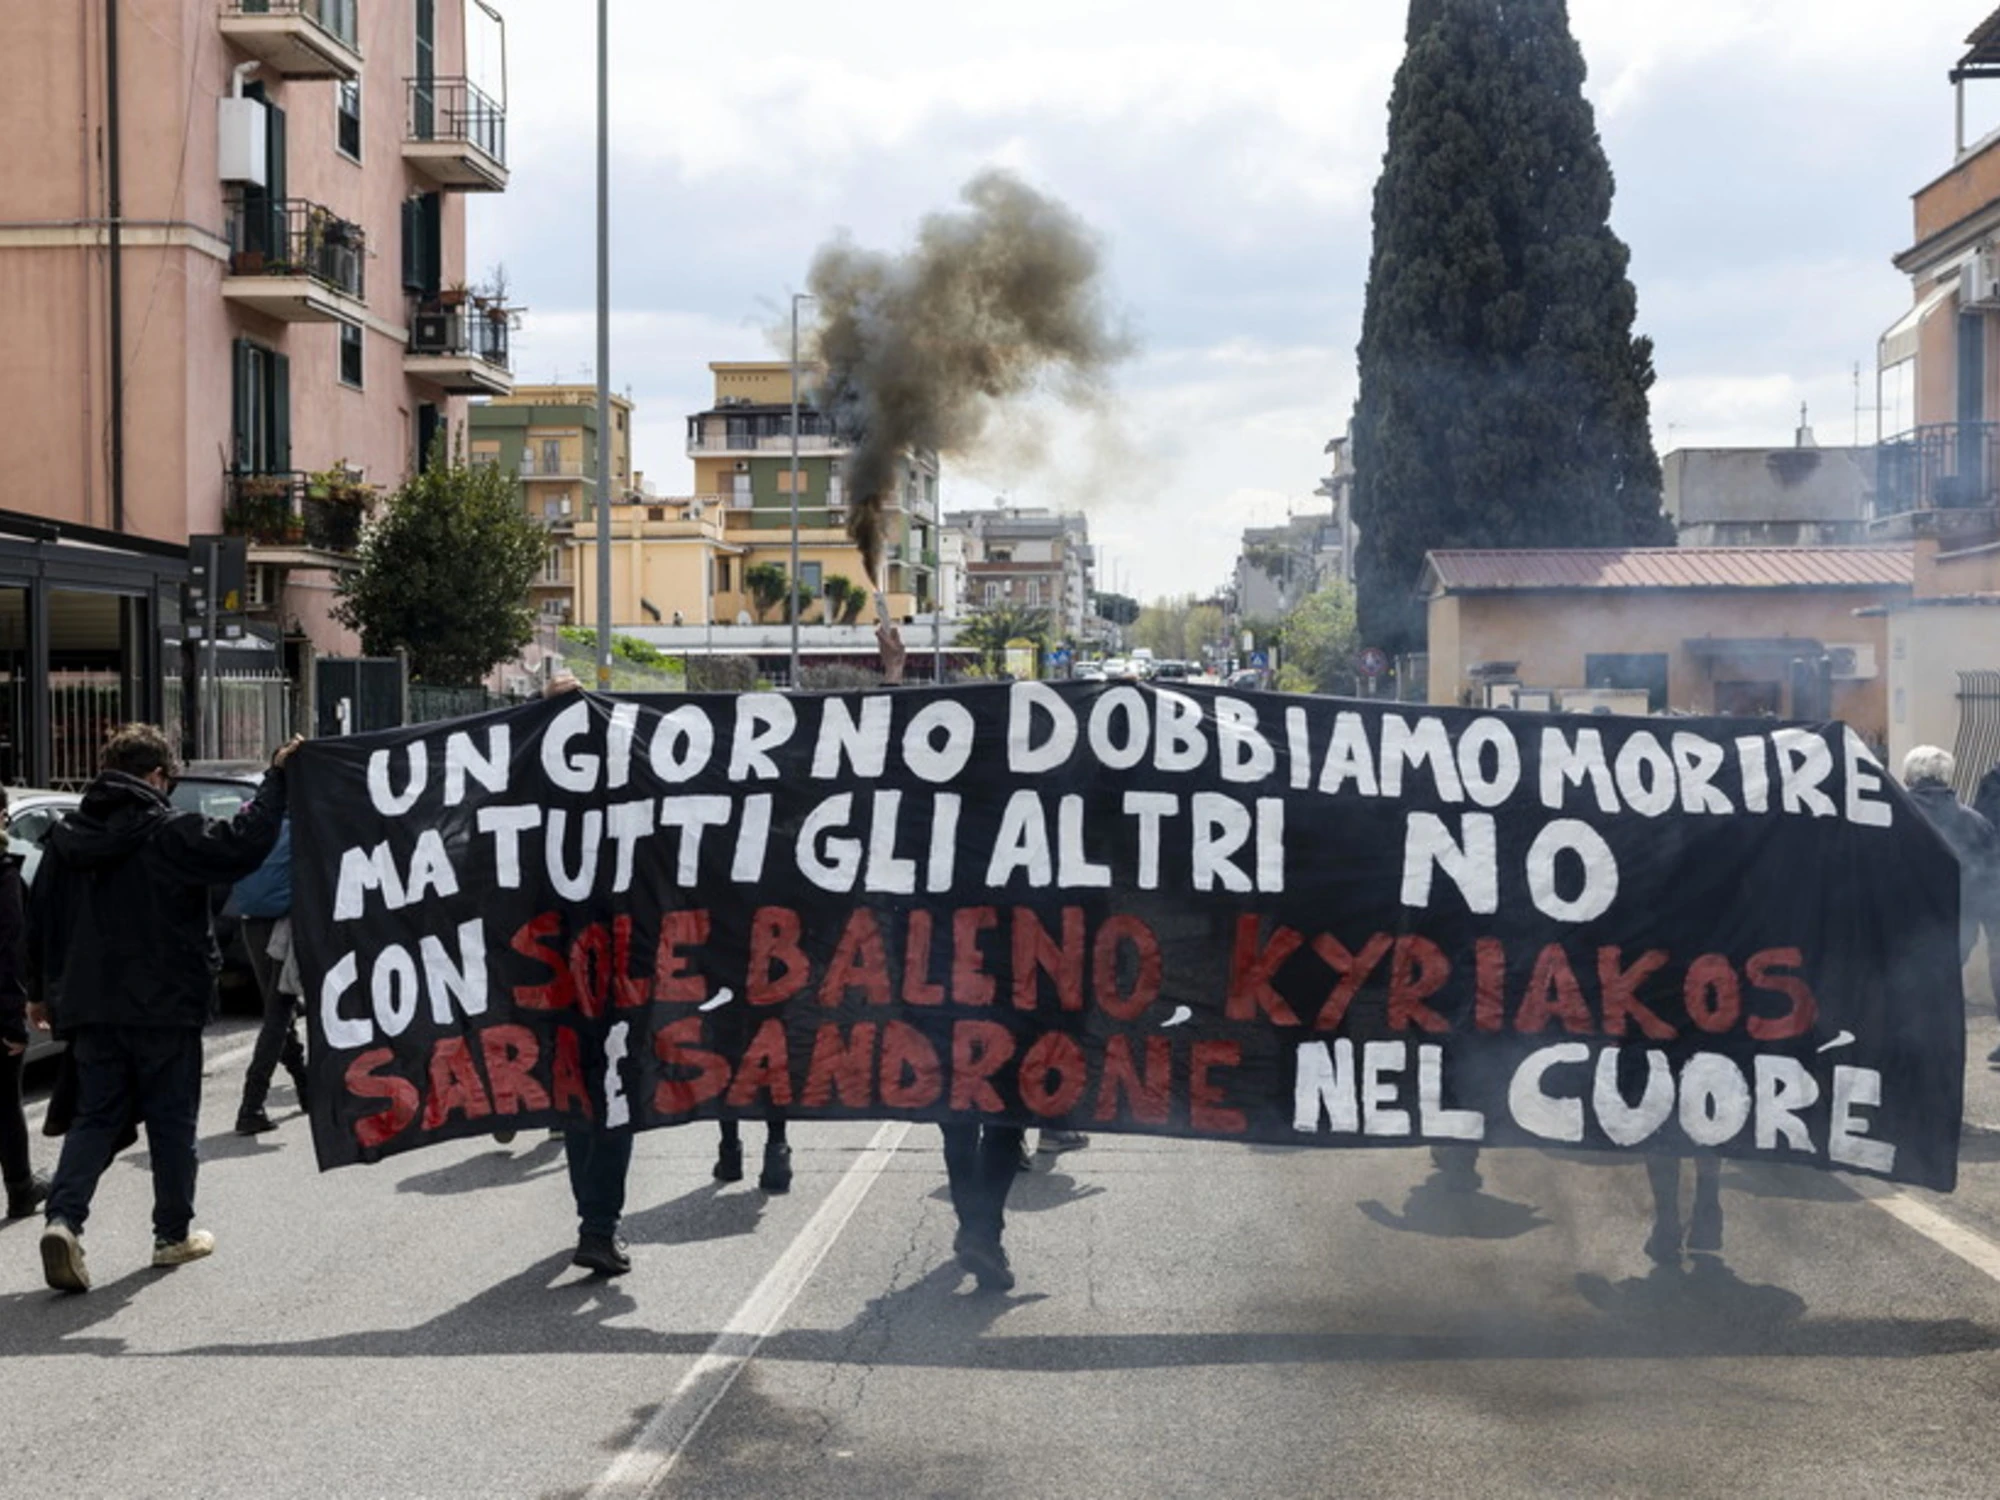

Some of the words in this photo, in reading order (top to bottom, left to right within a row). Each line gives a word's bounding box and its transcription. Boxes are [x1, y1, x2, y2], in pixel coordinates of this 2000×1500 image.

[367, 724, 511, 816] UN
[541, 692, 974, 792] GIORNO
[1007, 681, 1521, 807] DOBBIAMO
[1540, 725, 1893, 827] MORIRE
[333, 828, 459, 921] MA
[476, 793, 772, 901] TUTTI
[795, 789, 961, 894] GLI
[985, 790, 1285, 893] ALTRI
[1400, 811, 1619, 922] NO
[320, 918, 488, 1049] CON
[344, 1022, 594, 1149] SARA
[653, 1015, 1247, 1133] SANDRONE
[1293, 1038, 1485, 1140] NEL
